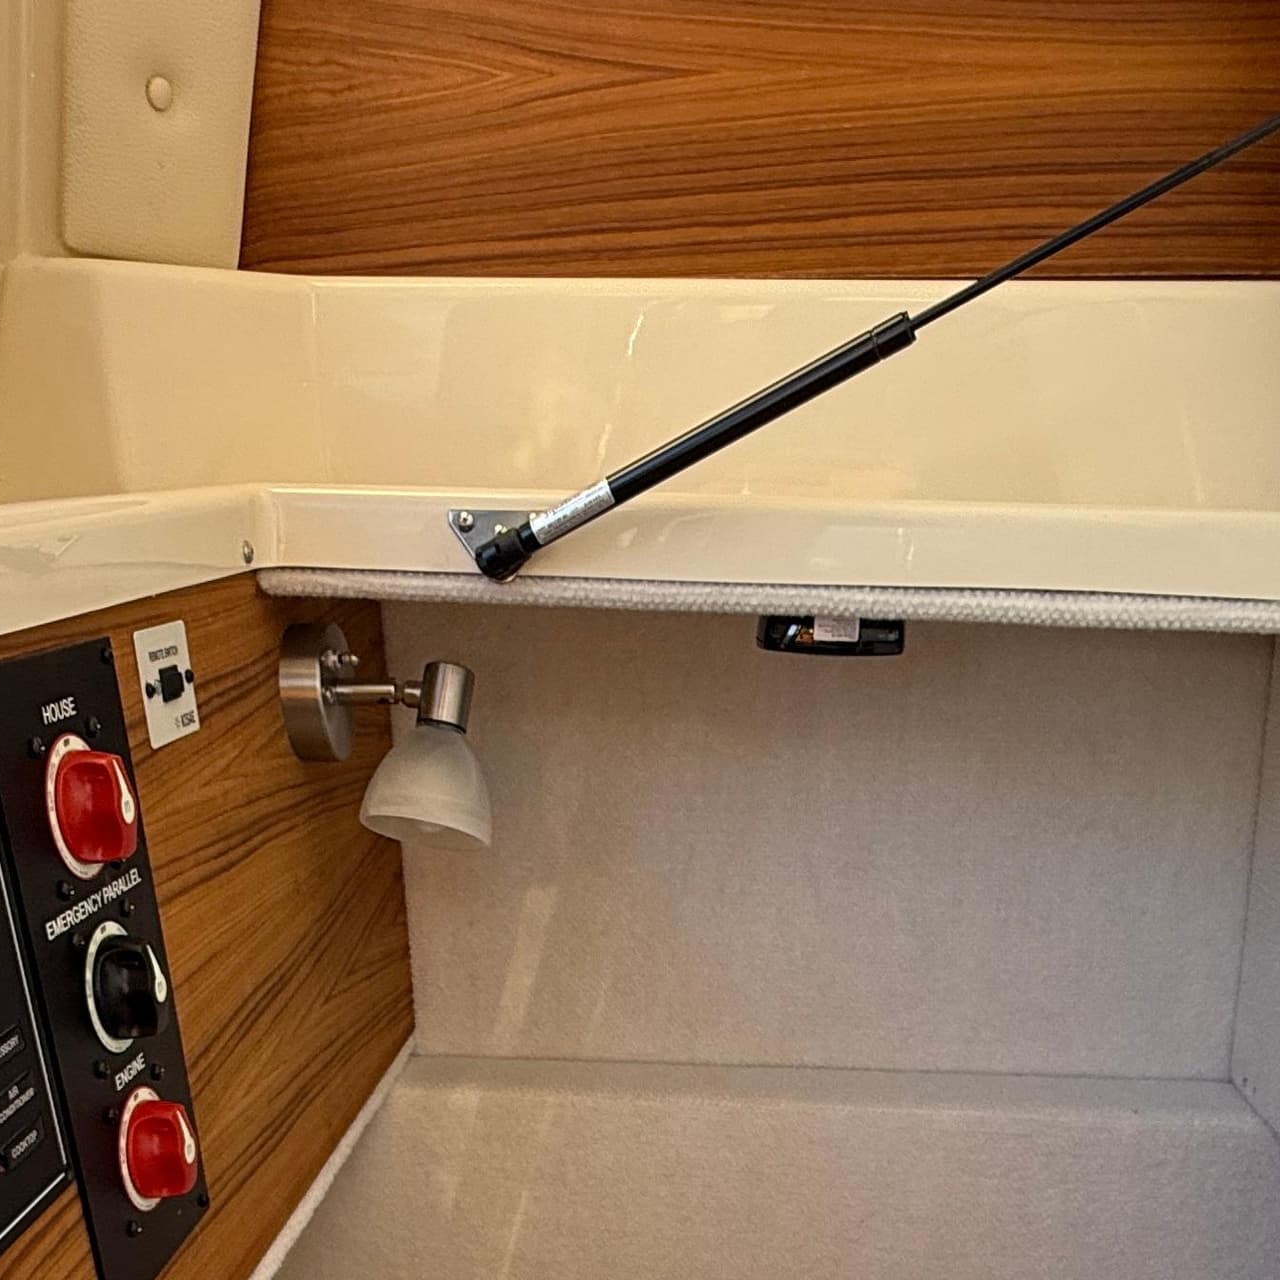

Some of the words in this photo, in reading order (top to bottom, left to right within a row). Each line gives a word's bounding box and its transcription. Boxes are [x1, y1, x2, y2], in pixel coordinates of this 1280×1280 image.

[41, 696, 77, 725] HOUSE
[45, 891, 103, 941] EMERGENCY
[102, 867, 142, 902] PARALLEL
[115, 1052, 147, 1092] ENGINE
